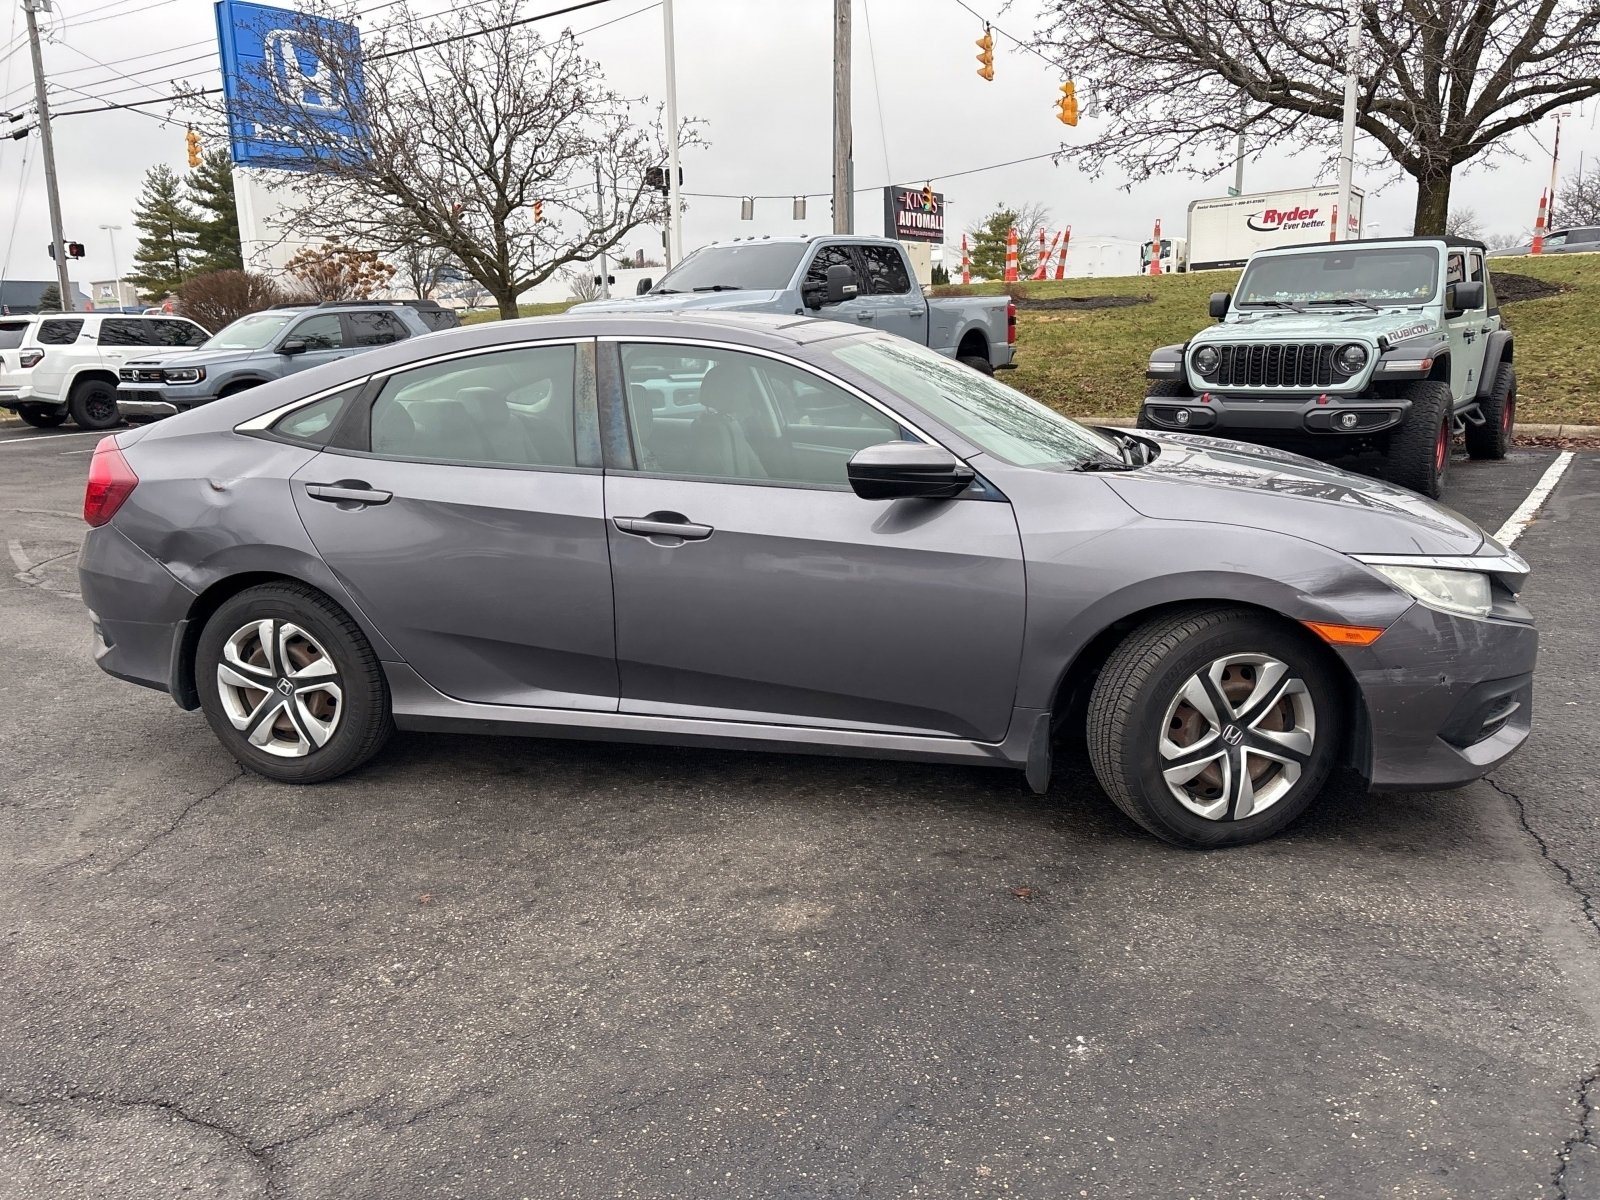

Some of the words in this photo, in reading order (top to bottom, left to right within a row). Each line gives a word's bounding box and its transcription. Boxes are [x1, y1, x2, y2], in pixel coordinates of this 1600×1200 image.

[905, 192, 938, 213] KINS
[900, 211, 944, 230] AUTOMALL
[1263, 207, 1318, 225] Ryder
[1283, 222, 1299, 230] Ever
[1388, 324, 1429, 341] RUBICON
